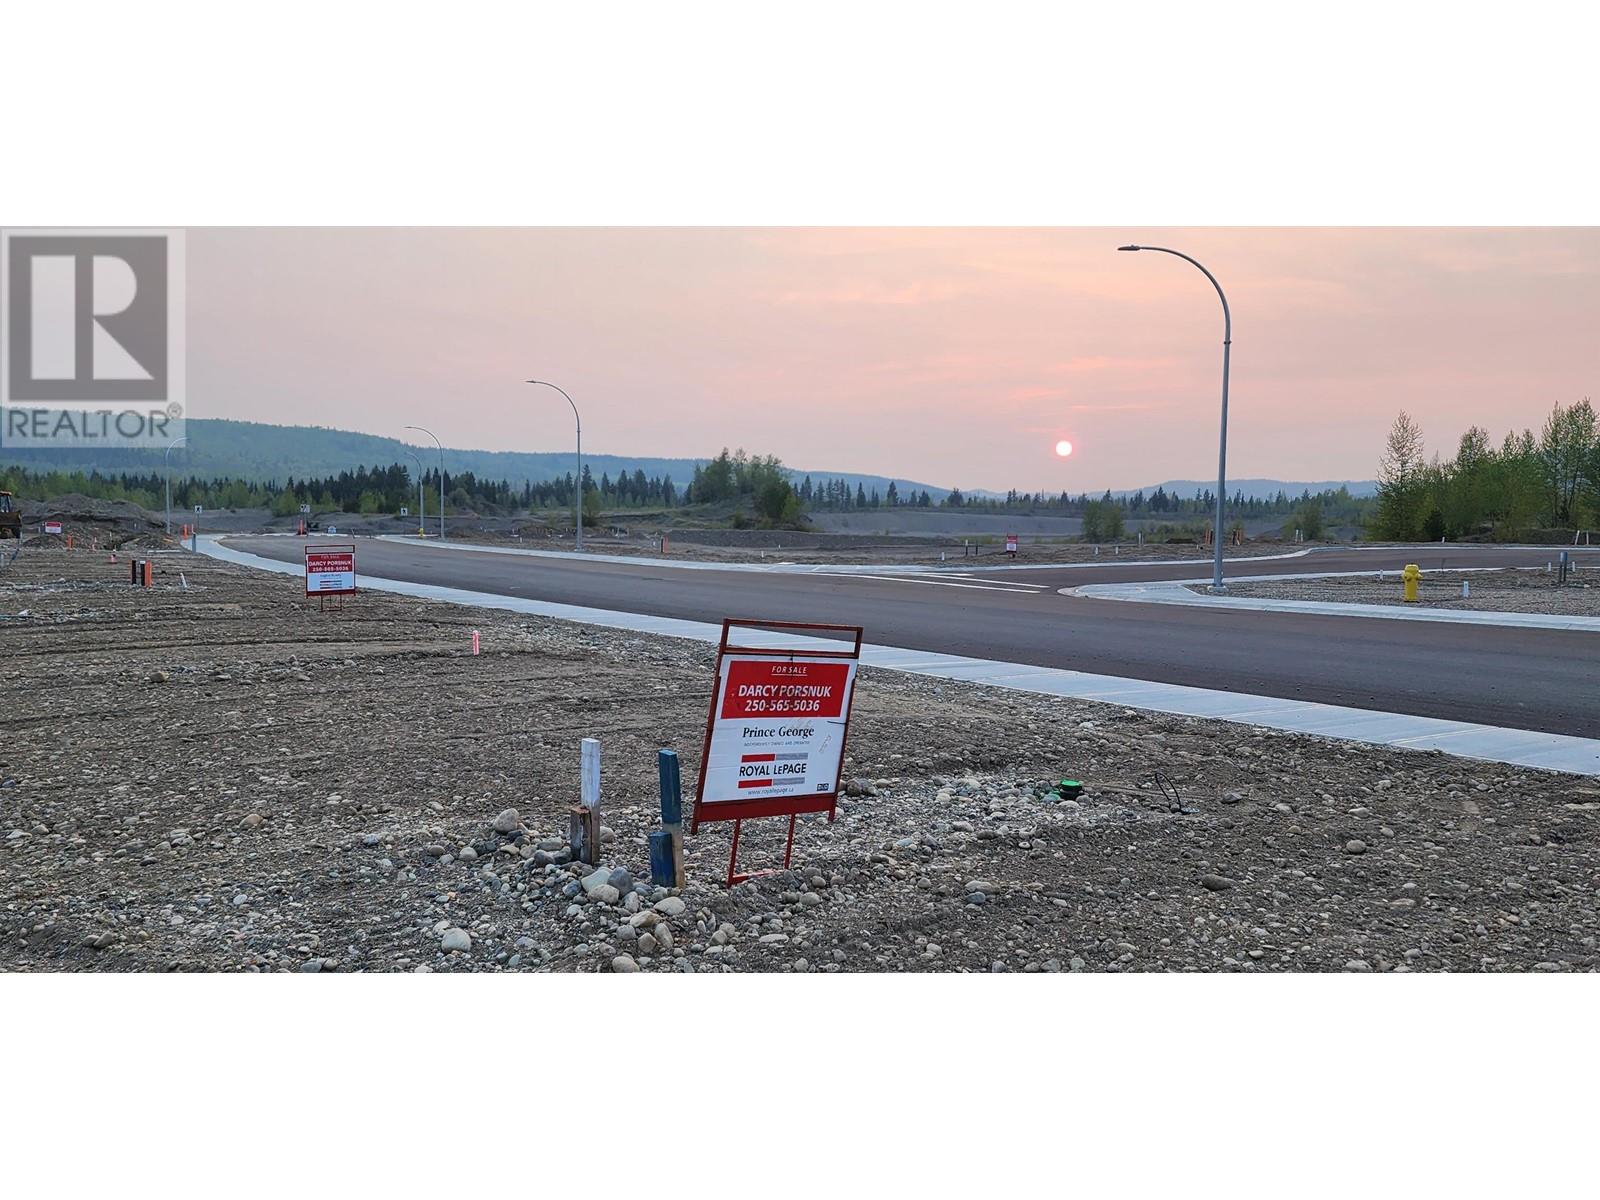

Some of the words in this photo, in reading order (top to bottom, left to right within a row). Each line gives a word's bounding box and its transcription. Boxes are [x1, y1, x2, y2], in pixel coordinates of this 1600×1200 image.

[772, 665, 787, 674] FOR
[788, 666, 808, 674] SALE
[738, 685, 778, 697] DARCY
[779, 685, 832, 697] PORSNUK
[744, 699, 820, 712] 250-565-5036
[742, 727, 776, 738] Prince
[778, 726, 815, 739] George
[739, 765, 770, 777] ROYAL
